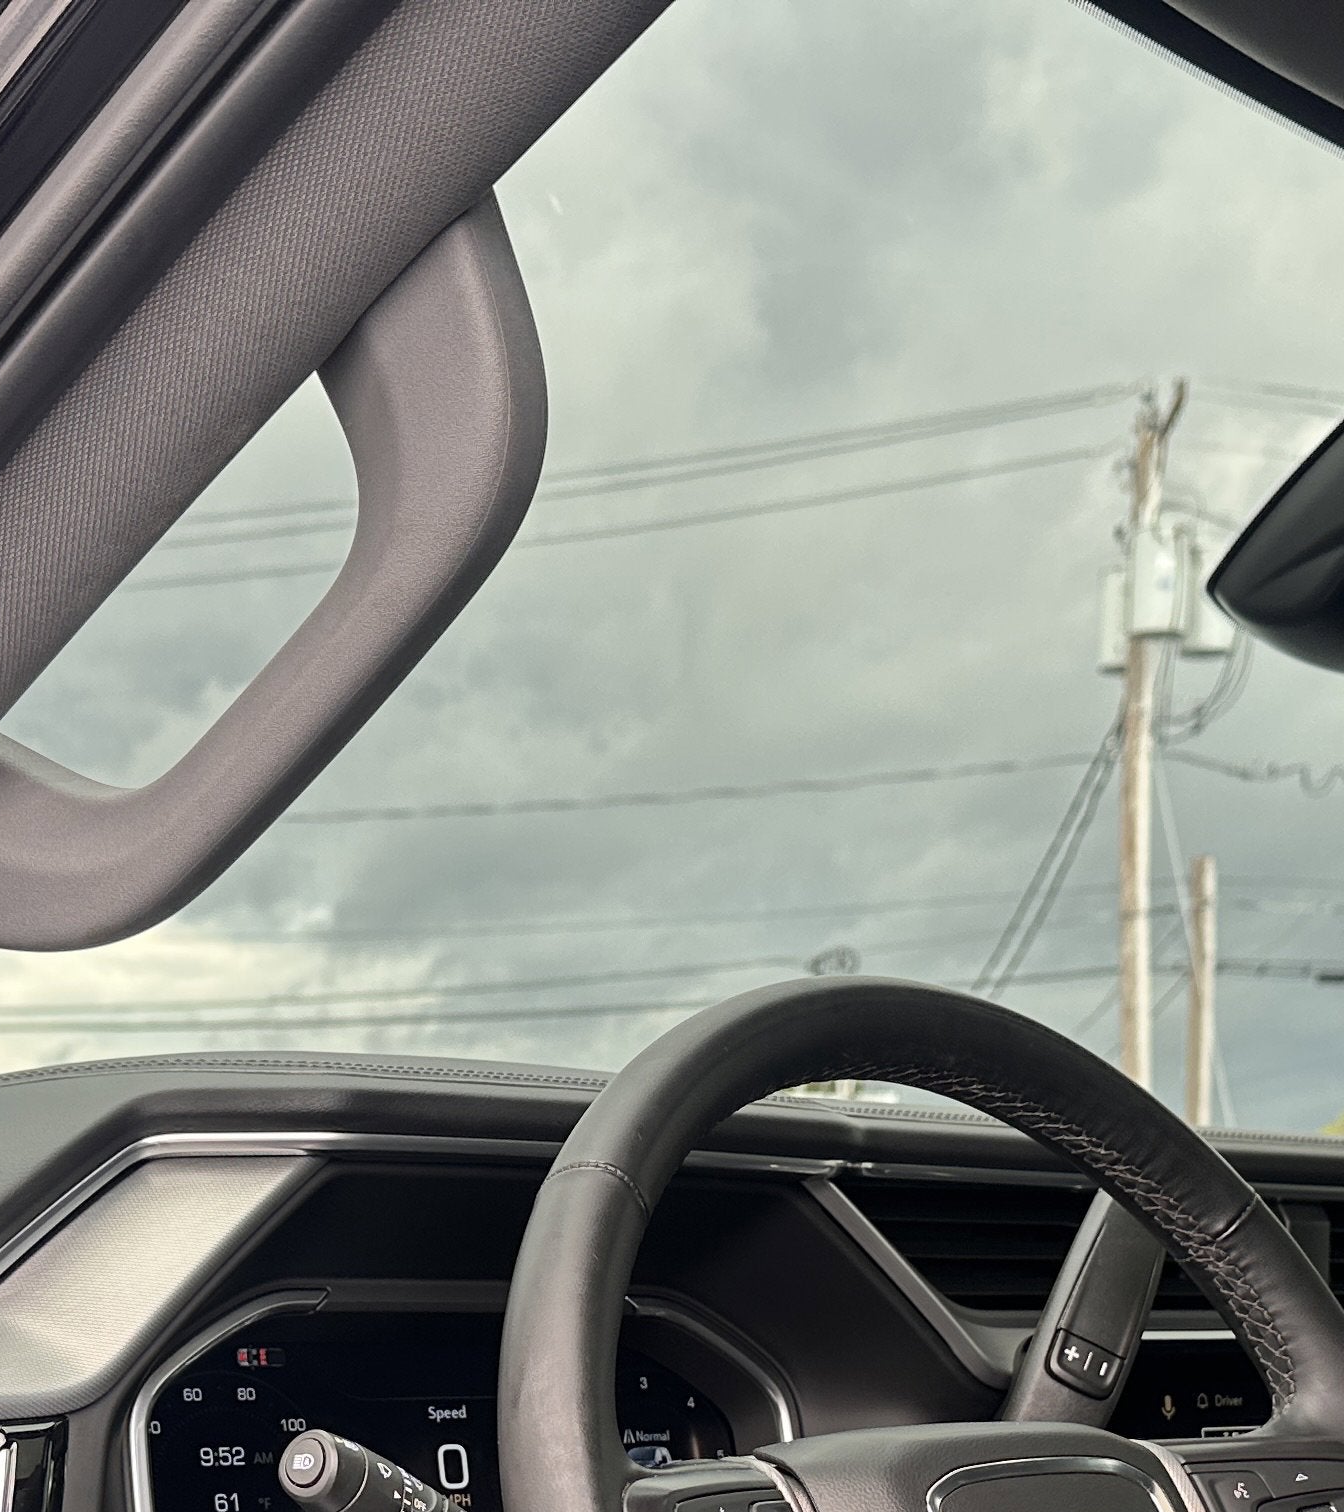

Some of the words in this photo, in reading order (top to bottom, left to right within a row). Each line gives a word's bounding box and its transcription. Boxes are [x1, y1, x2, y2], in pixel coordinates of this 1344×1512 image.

[639, 1376, 649, 1390] 3
[182, 1388, 203, 1402] 60
[237, 1387, 257, 1401] 80
[1214, 1394, 1243, 1407] Driver
[686, 1396, 696, 1409] 4
[428, 1404, 468, 1423] Speed
[148, 1421, 162, 1435] 0
[279, 1418, 307, 1432] 100
[636, 1429, 671, 1442] Normal
[199, 1446, 246, 1467] 9:52
[253, 1451, 274, 1465] AM
[437, 1443, 470, 1490] 0
[214, 1492, 240, 1512] 61
